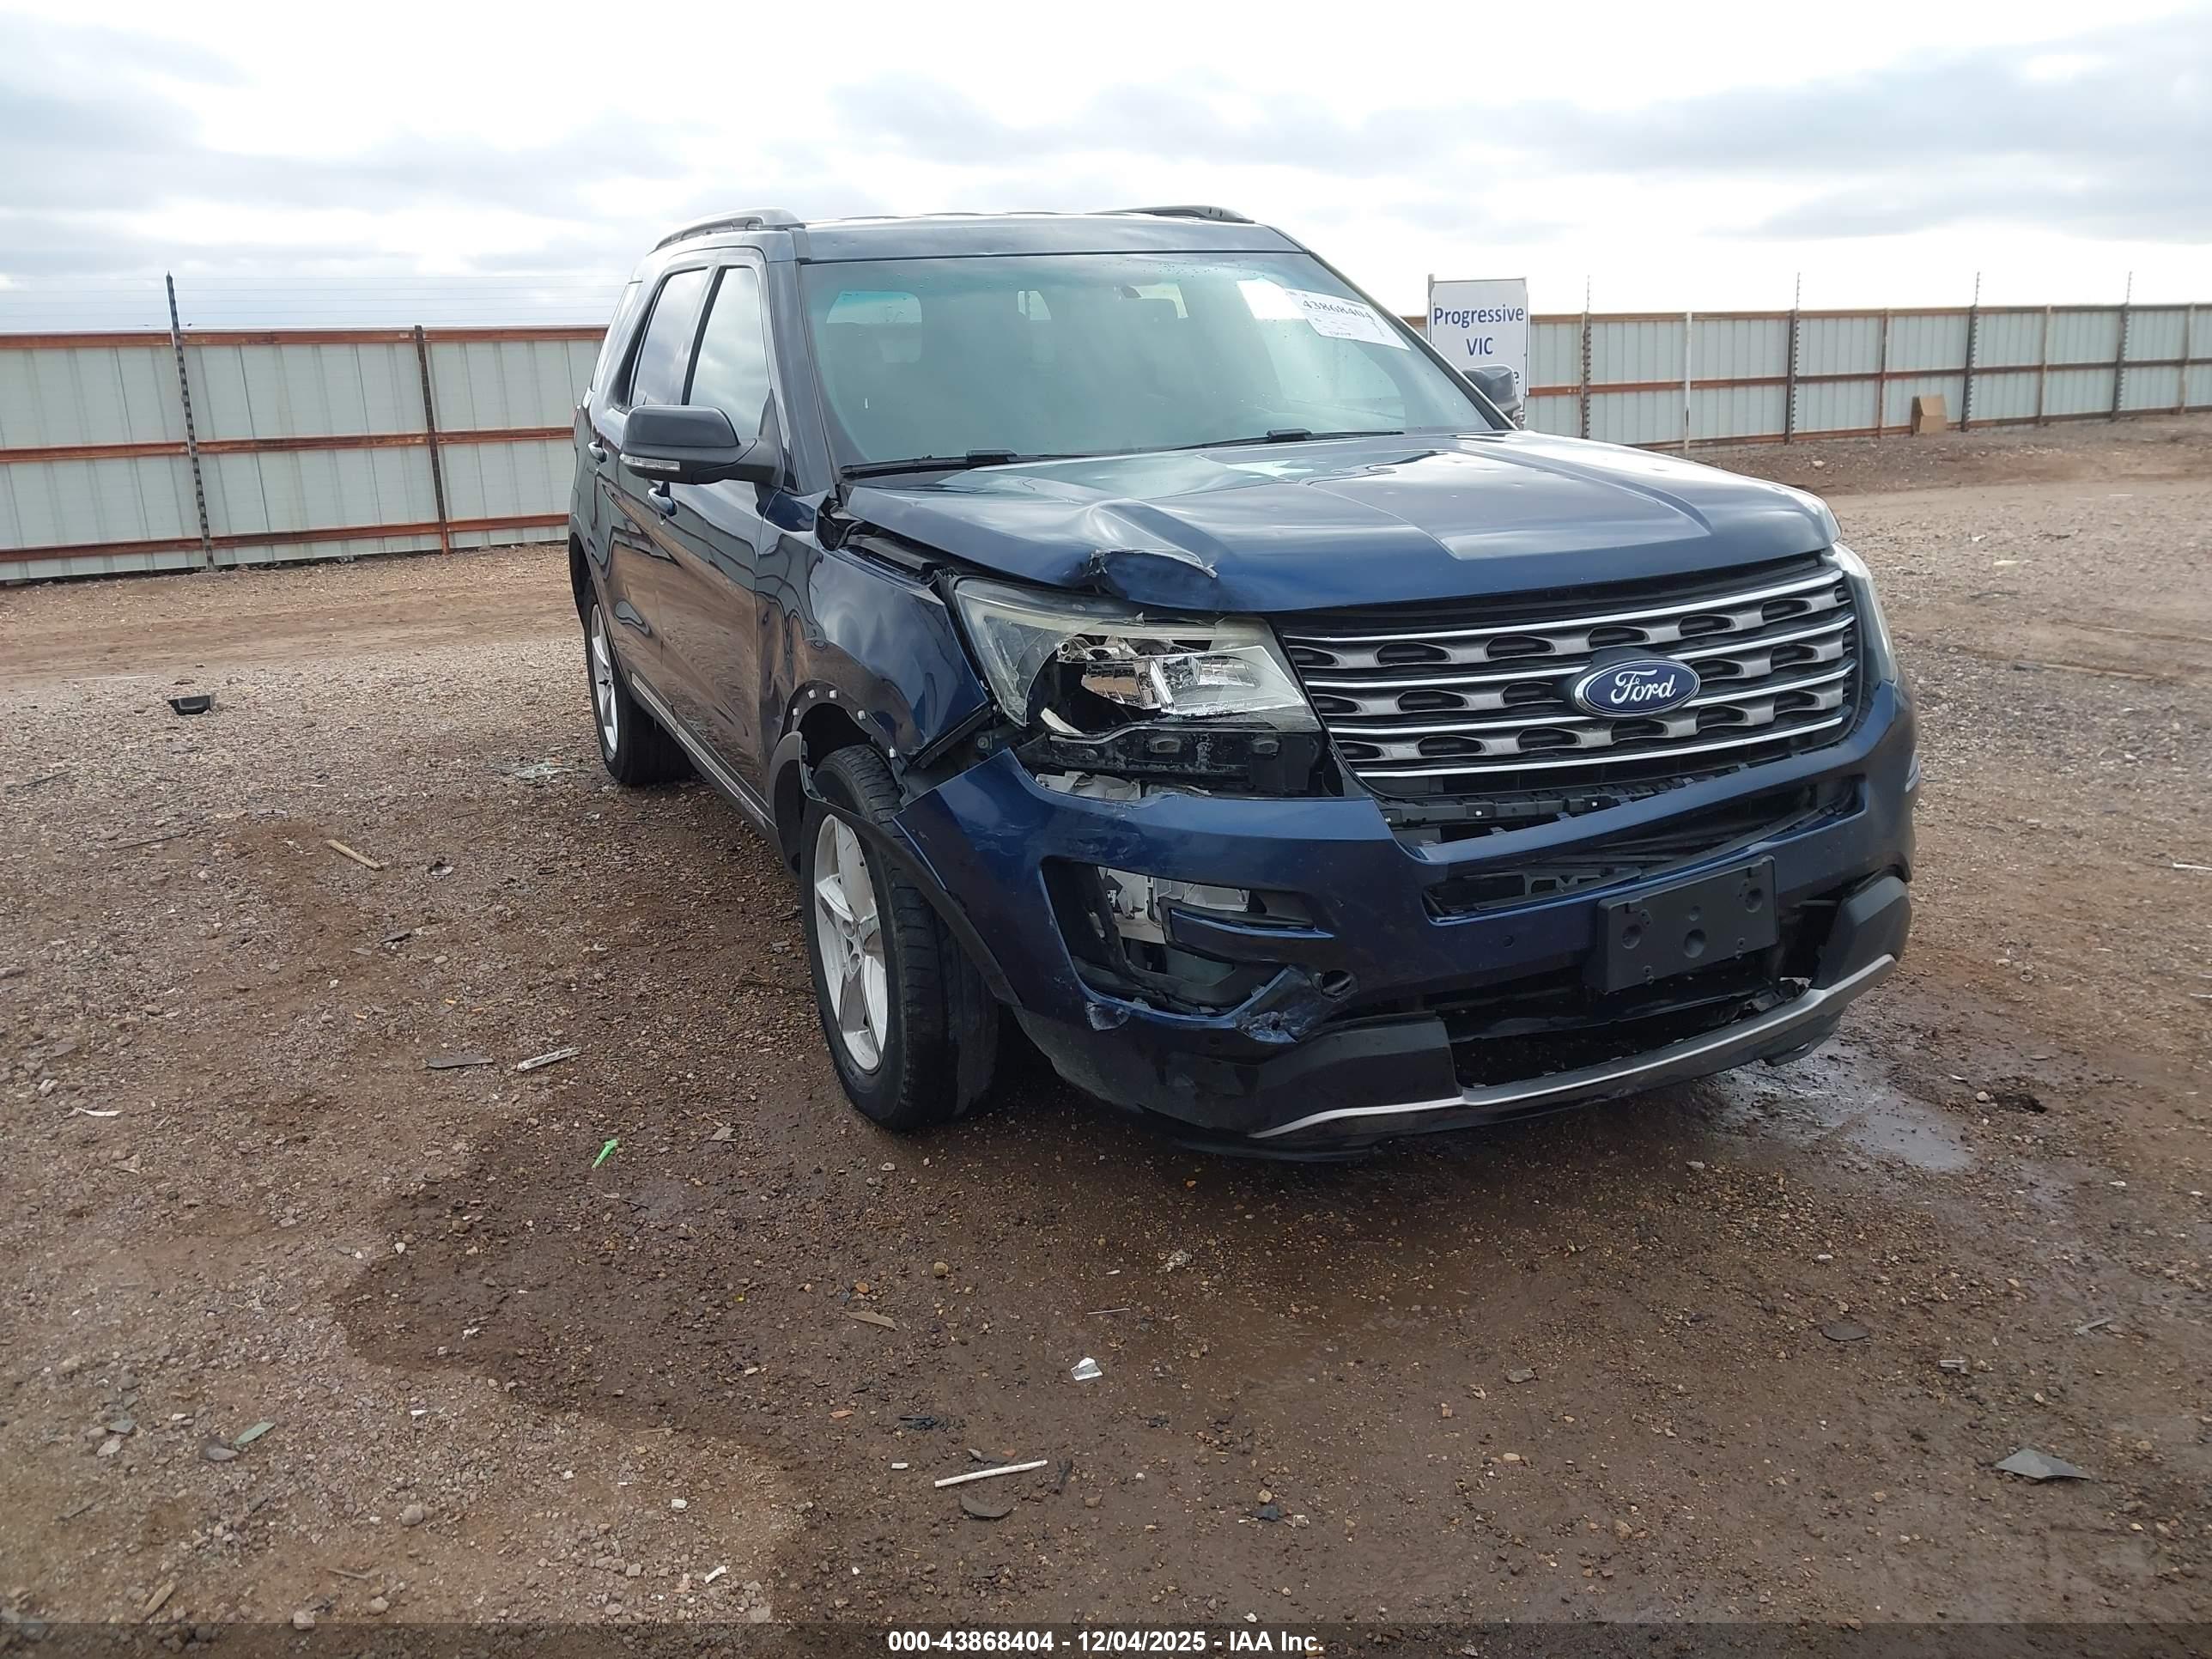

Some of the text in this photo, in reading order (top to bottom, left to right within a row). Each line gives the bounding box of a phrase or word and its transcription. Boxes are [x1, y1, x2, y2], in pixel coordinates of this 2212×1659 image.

[1434, 303, 1524, 328] Progressive
[1466, 337, 1493, 356] VIC
[1610, 669, 1677, 704] Ford
